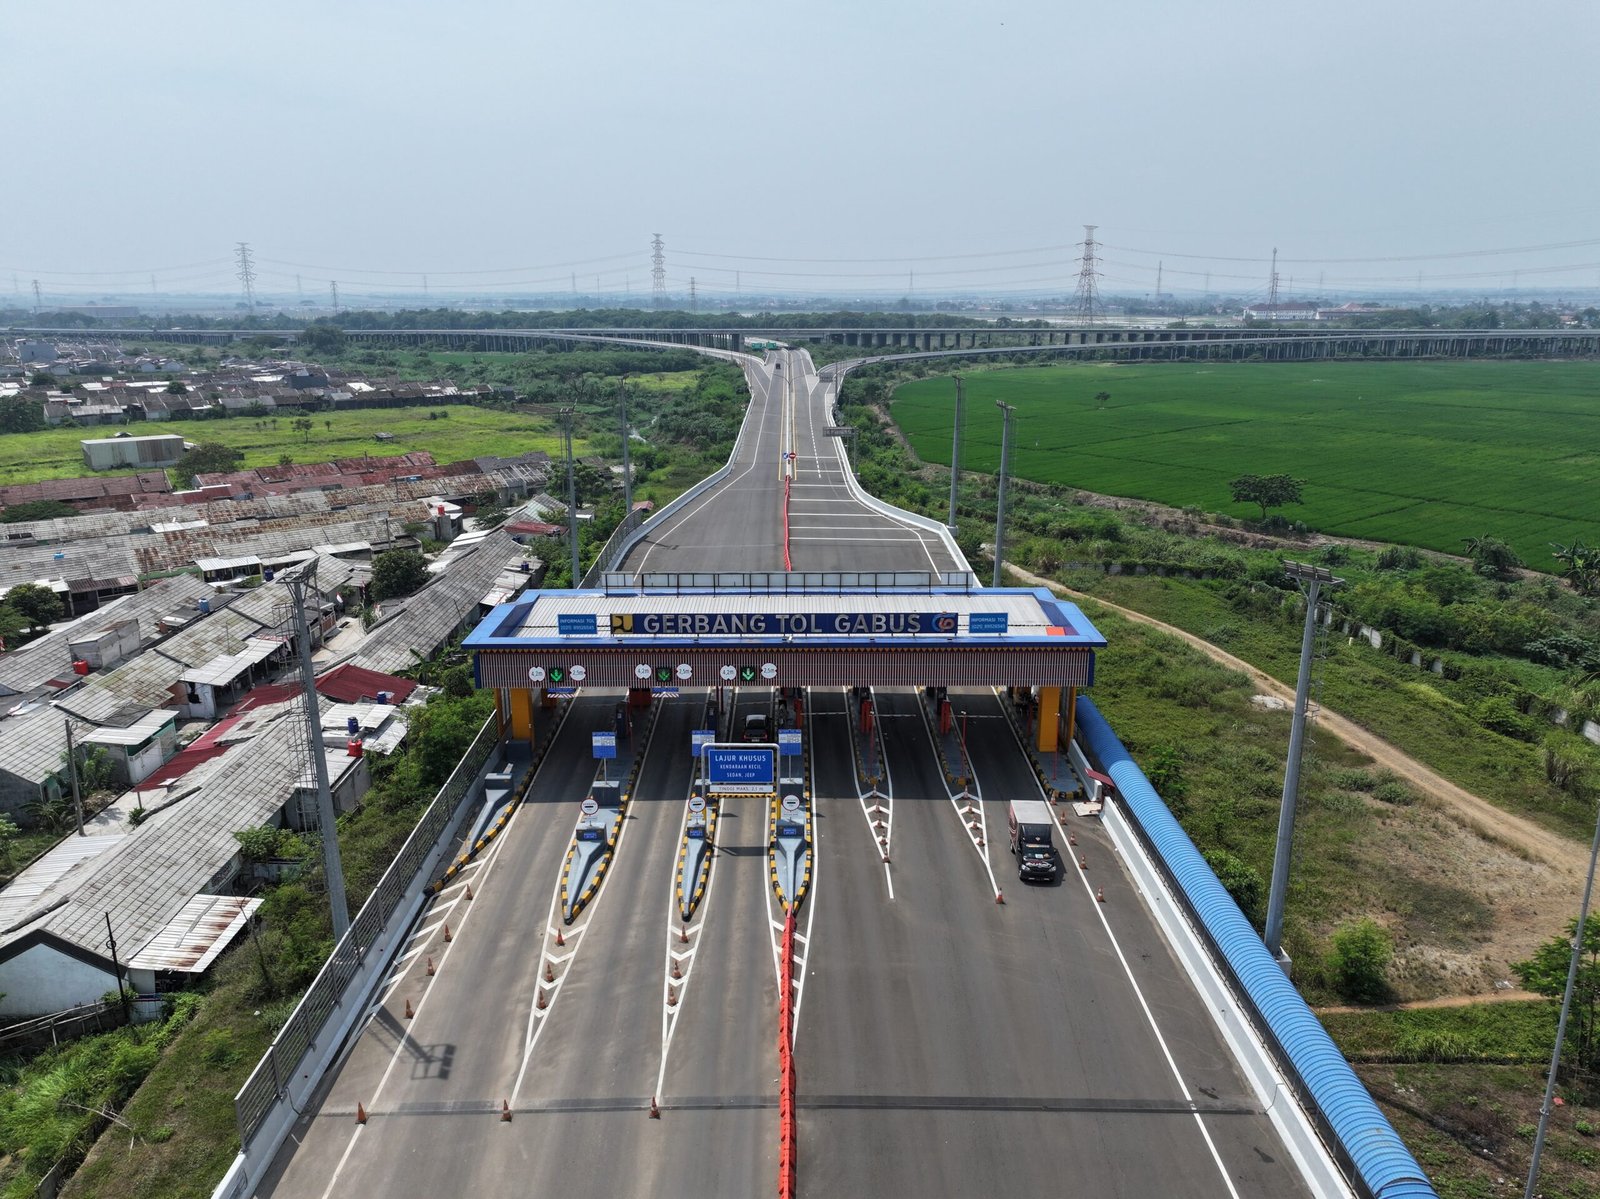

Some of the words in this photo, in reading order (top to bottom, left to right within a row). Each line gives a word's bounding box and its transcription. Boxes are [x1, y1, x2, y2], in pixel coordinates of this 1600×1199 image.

[644, 614, 766, 633] GERBANG
[776, 614, 822, 633] TOL
[835, 614, 921, 633] GABUS
